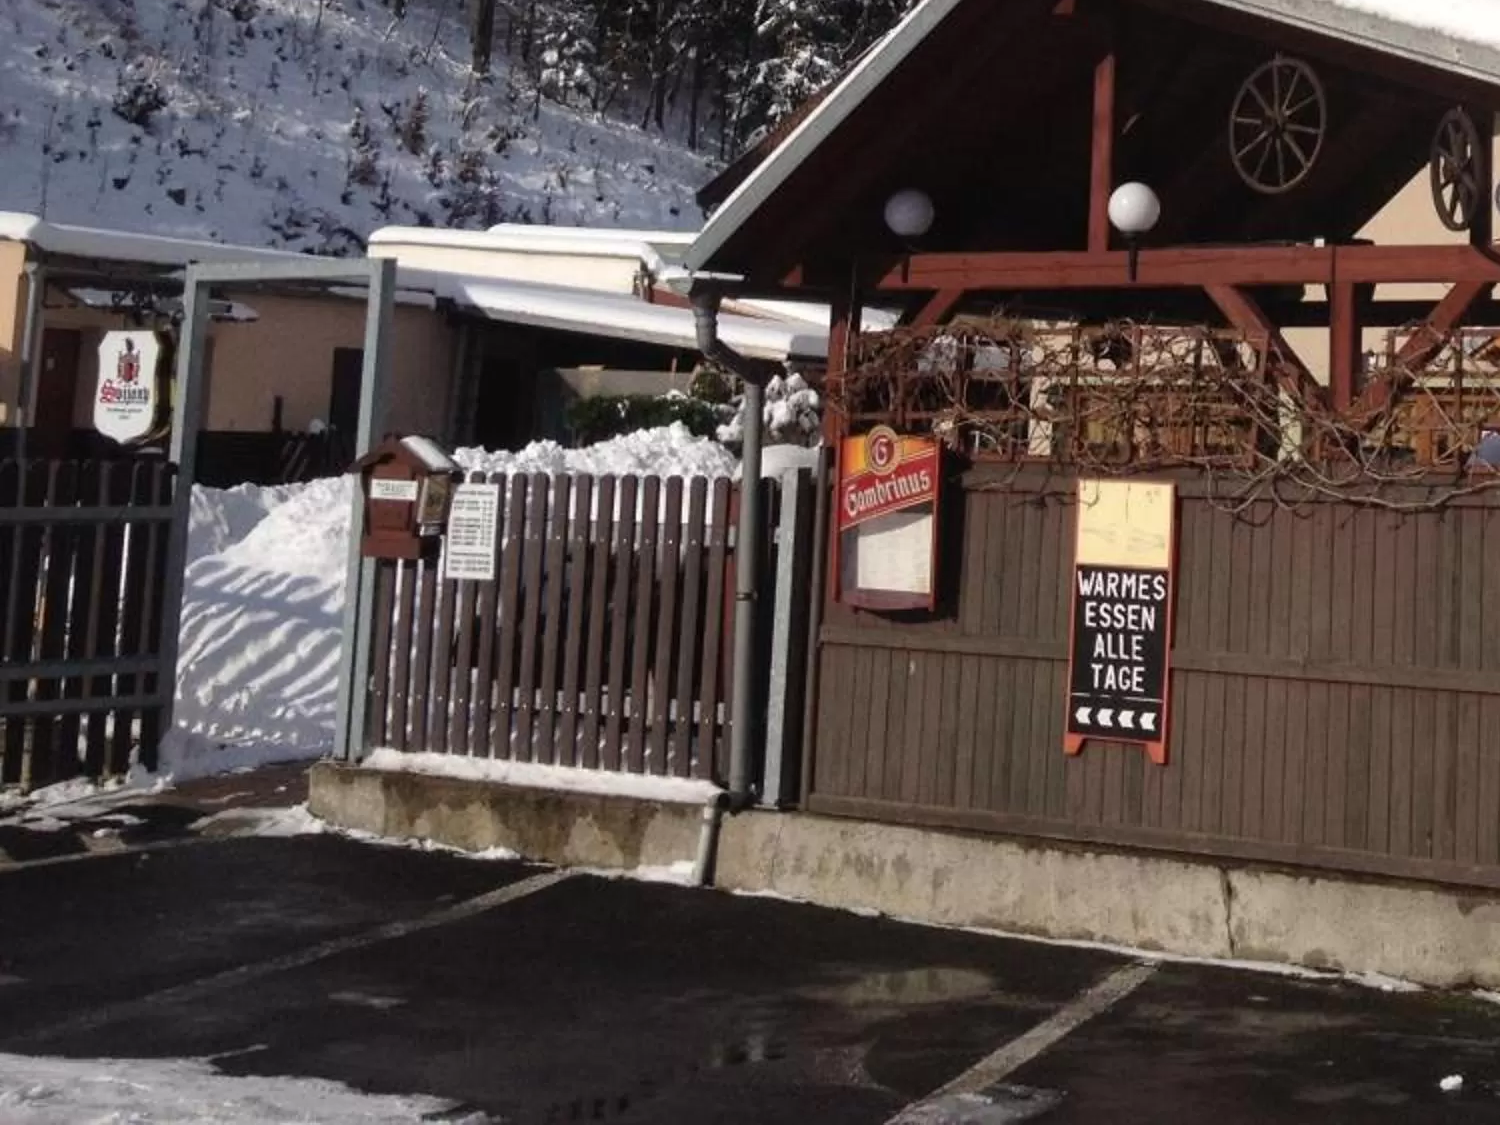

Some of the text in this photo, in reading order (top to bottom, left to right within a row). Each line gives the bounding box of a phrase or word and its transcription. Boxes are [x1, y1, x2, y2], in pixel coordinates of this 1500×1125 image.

[844, 469, 931, 518] Gambrinus
[1077, 570, 1167, 601] WARMES
[1085, 602, 1155, 632] ESSEN
[1093, 632, 1145, 662] ALLE
[1091, 662, 1145, 693] TAGE
